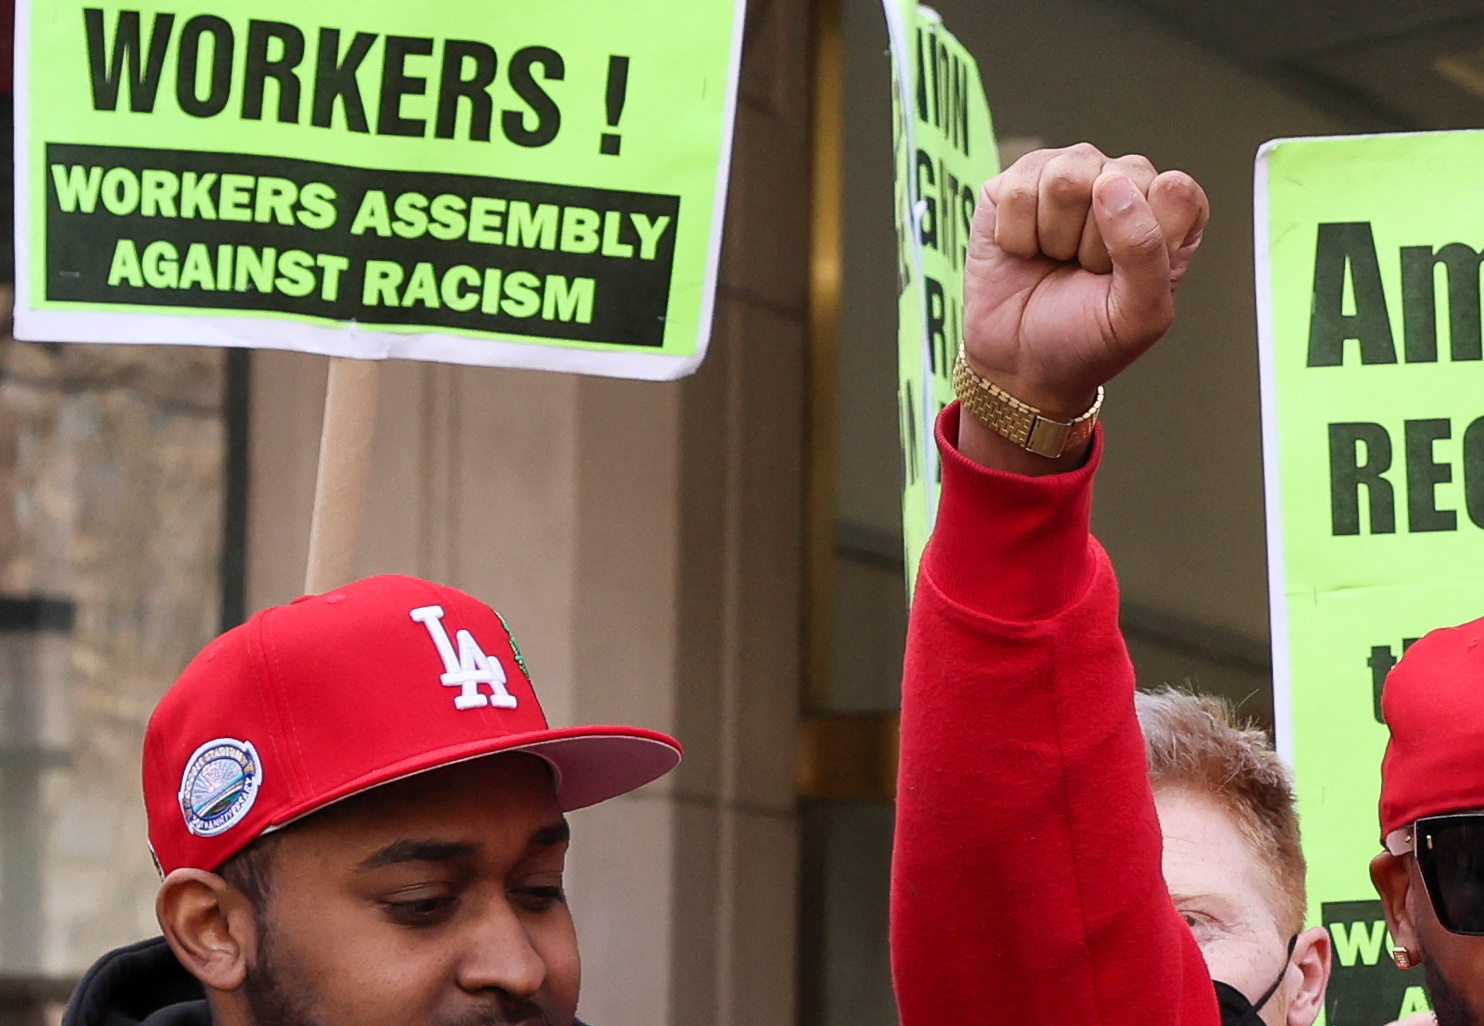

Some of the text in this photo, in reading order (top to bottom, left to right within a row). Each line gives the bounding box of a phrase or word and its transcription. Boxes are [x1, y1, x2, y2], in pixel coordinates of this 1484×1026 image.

[82, 6, 631, 157] WORKERS !
[50, 163, 671, 262] WORKERS ASSEMBLY
[106, 238, 596, 325] AGAINST RACISM
[409, 604, 518, 710] LA
